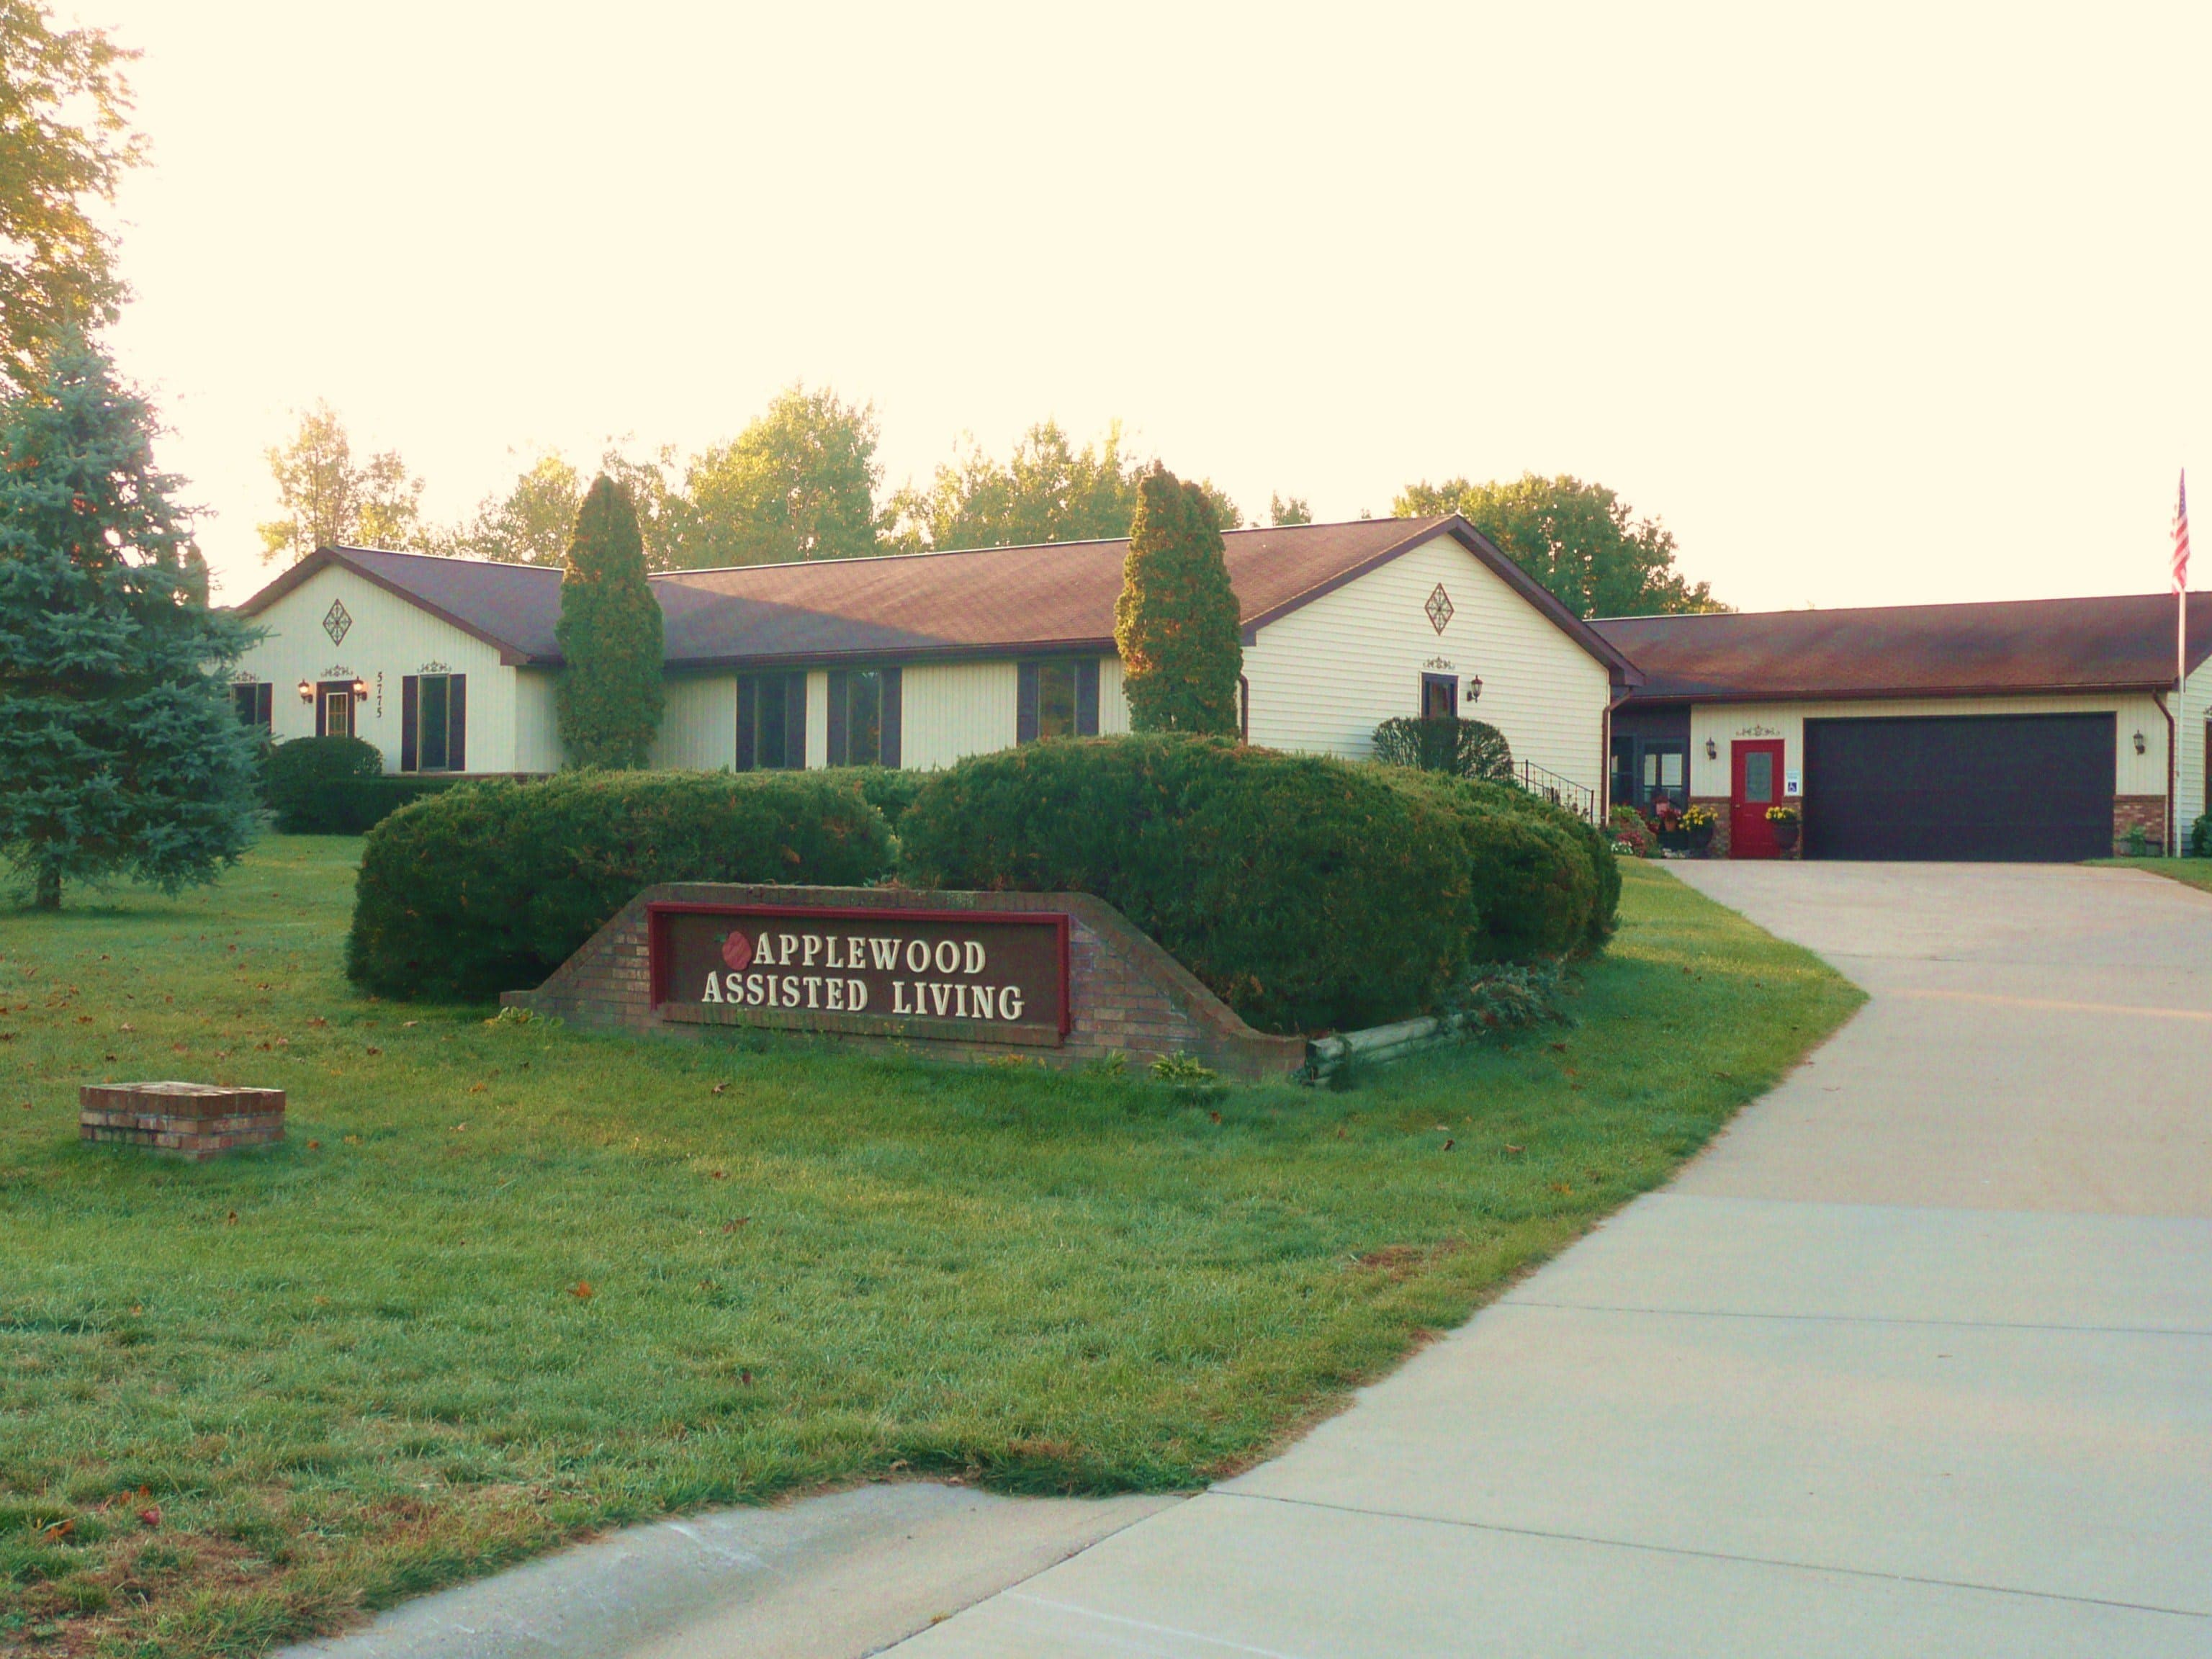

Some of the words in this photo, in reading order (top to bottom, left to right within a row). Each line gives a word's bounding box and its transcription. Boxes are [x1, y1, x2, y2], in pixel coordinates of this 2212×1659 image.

[753, 932, 986, 974] APPLEWOOD
[702, 970, 868, 1012] ASSISTED
[892, 981, 1024, 1020] LIVING
